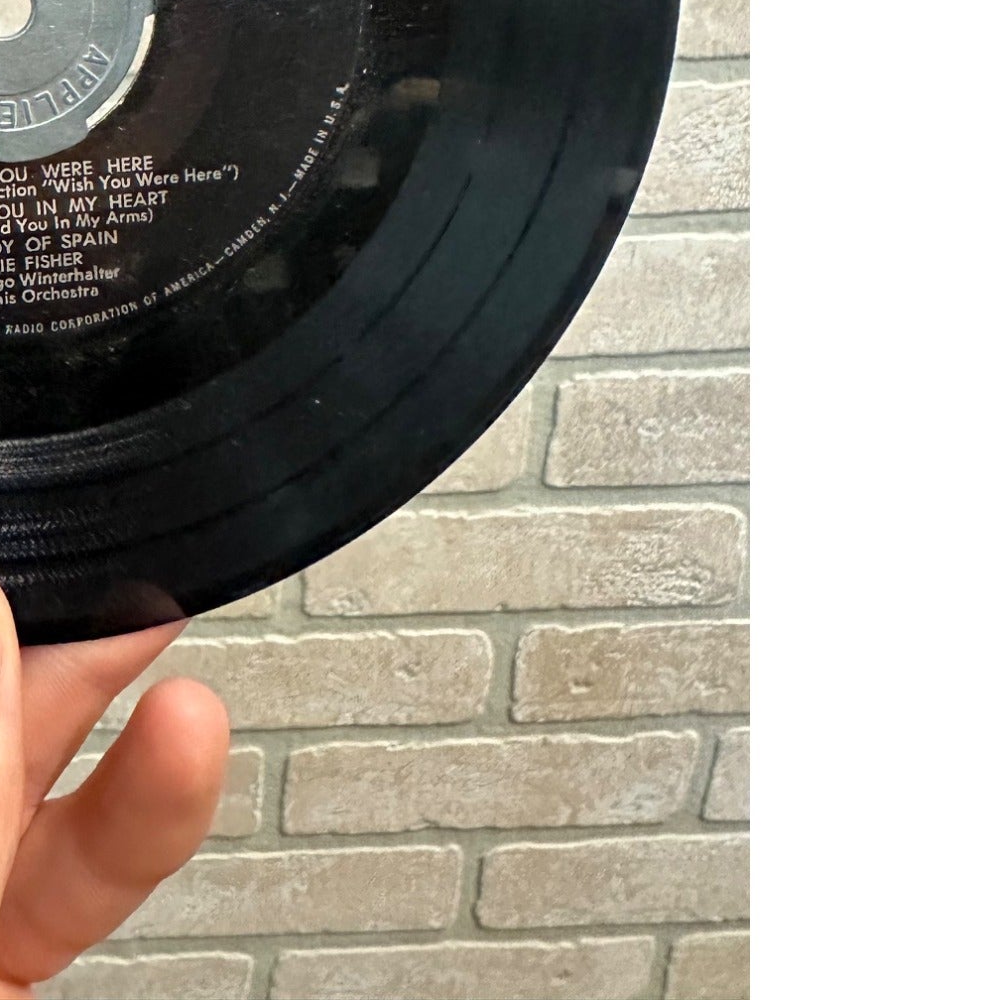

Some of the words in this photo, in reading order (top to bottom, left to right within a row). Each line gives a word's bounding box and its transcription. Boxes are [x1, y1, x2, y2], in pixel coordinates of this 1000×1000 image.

[41, 160, 93, 179] WERE
[107, 155, 154, 174] HERE
[98, 173, 131, 190] You
[135, 170, 179, 187] Were
[36, 198, 57, 216] IN
[68, 195, 98, 214] MY
[108, 189, 169, 210] HEART
[15, 218, 48, 234] You
[54, 216, 71, 230] In
[75, 213, 101, 230] My
[105, 208, 154, 225] Arms)
[25, 236, 51, 252] OF
[61, 229, 118, 250] SPAIN
[24, 251, 84, 271] FISHER
[21, 286, 100, 304] Orchestra
[5, 324, 44, 335] RADIO
[51, 300, 138, 332] CORPORATION
[143, 292, 157, 306] OF
